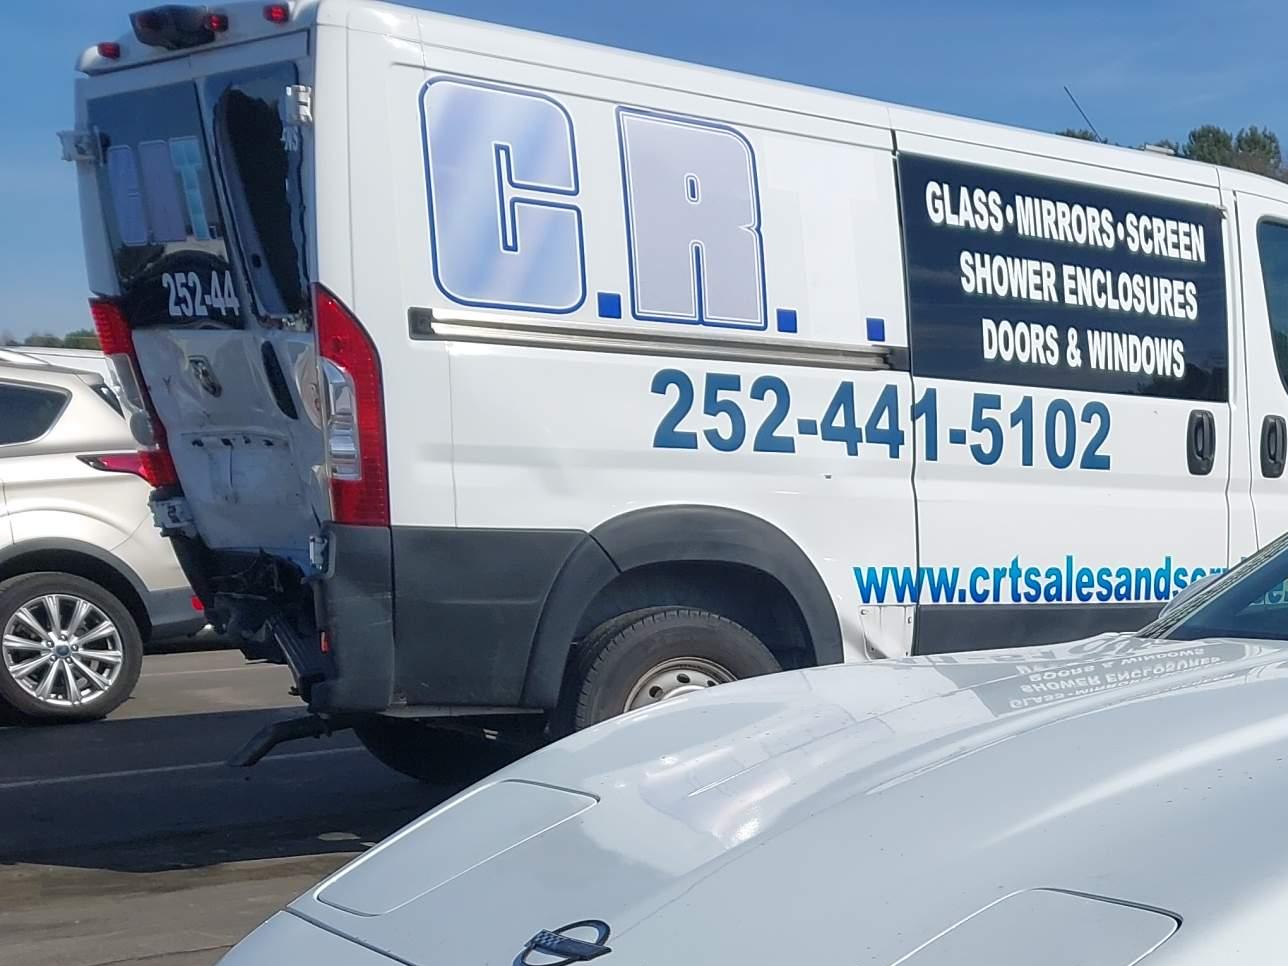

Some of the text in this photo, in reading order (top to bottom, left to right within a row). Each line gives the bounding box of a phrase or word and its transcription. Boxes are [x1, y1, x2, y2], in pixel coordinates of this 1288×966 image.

[960, 250, 1198, 320] SHOWER ENCLOSURES
[981, 318, 1185, 378] DOORS & WINDOWS
[650, 368, 1112, 471] 252-441-5102
